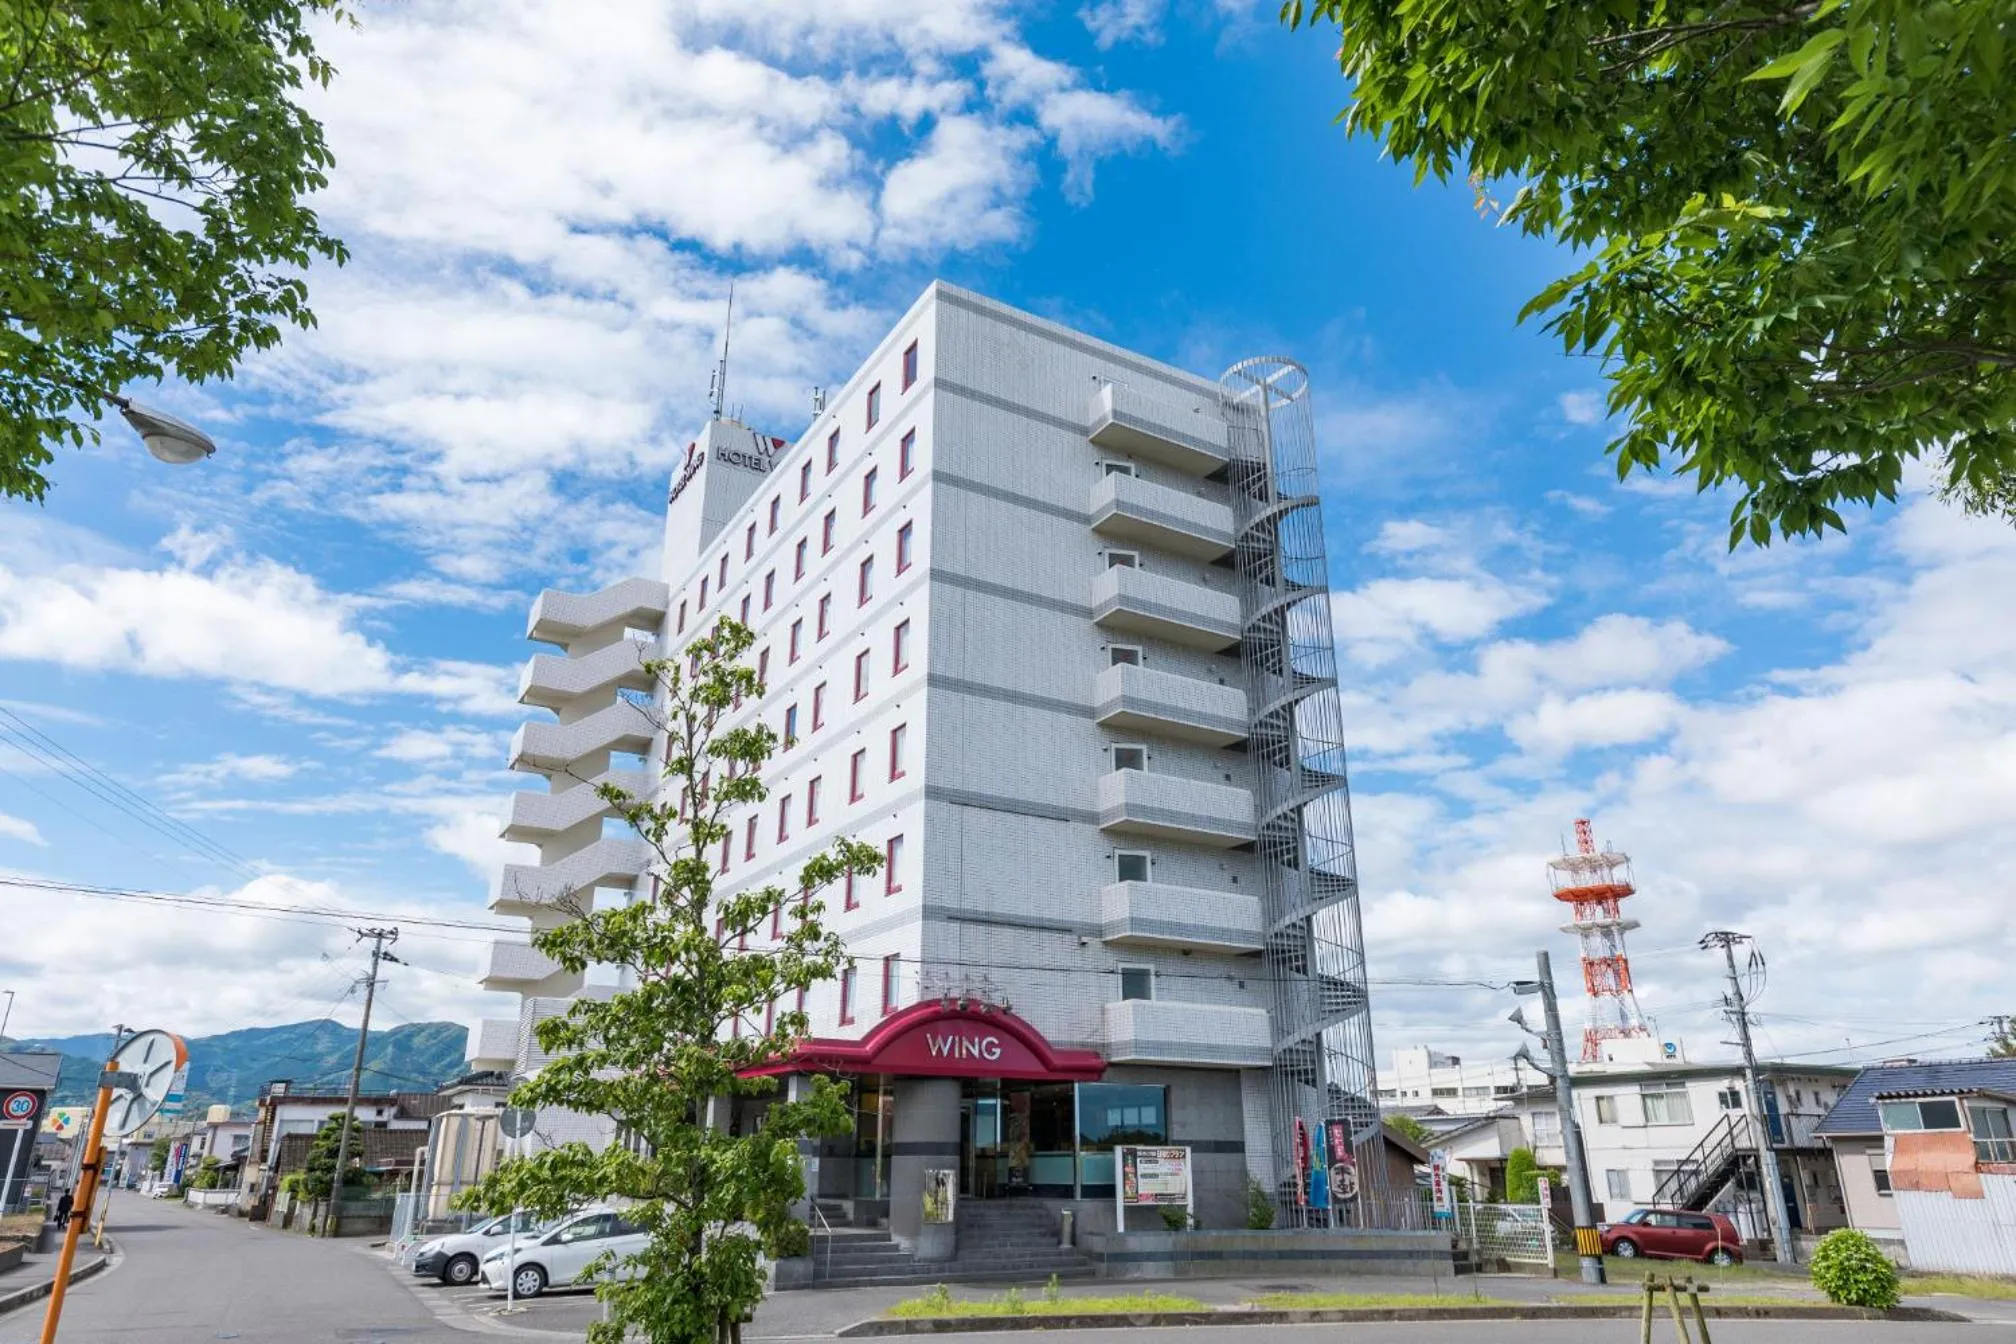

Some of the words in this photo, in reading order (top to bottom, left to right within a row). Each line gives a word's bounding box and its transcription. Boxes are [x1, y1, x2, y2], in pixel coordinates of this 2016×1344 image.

[716, 446, 766, 472] HOTEL
[926, 1033, 1002, 1060] WING
[12, 1100, 30, 1112] 30
